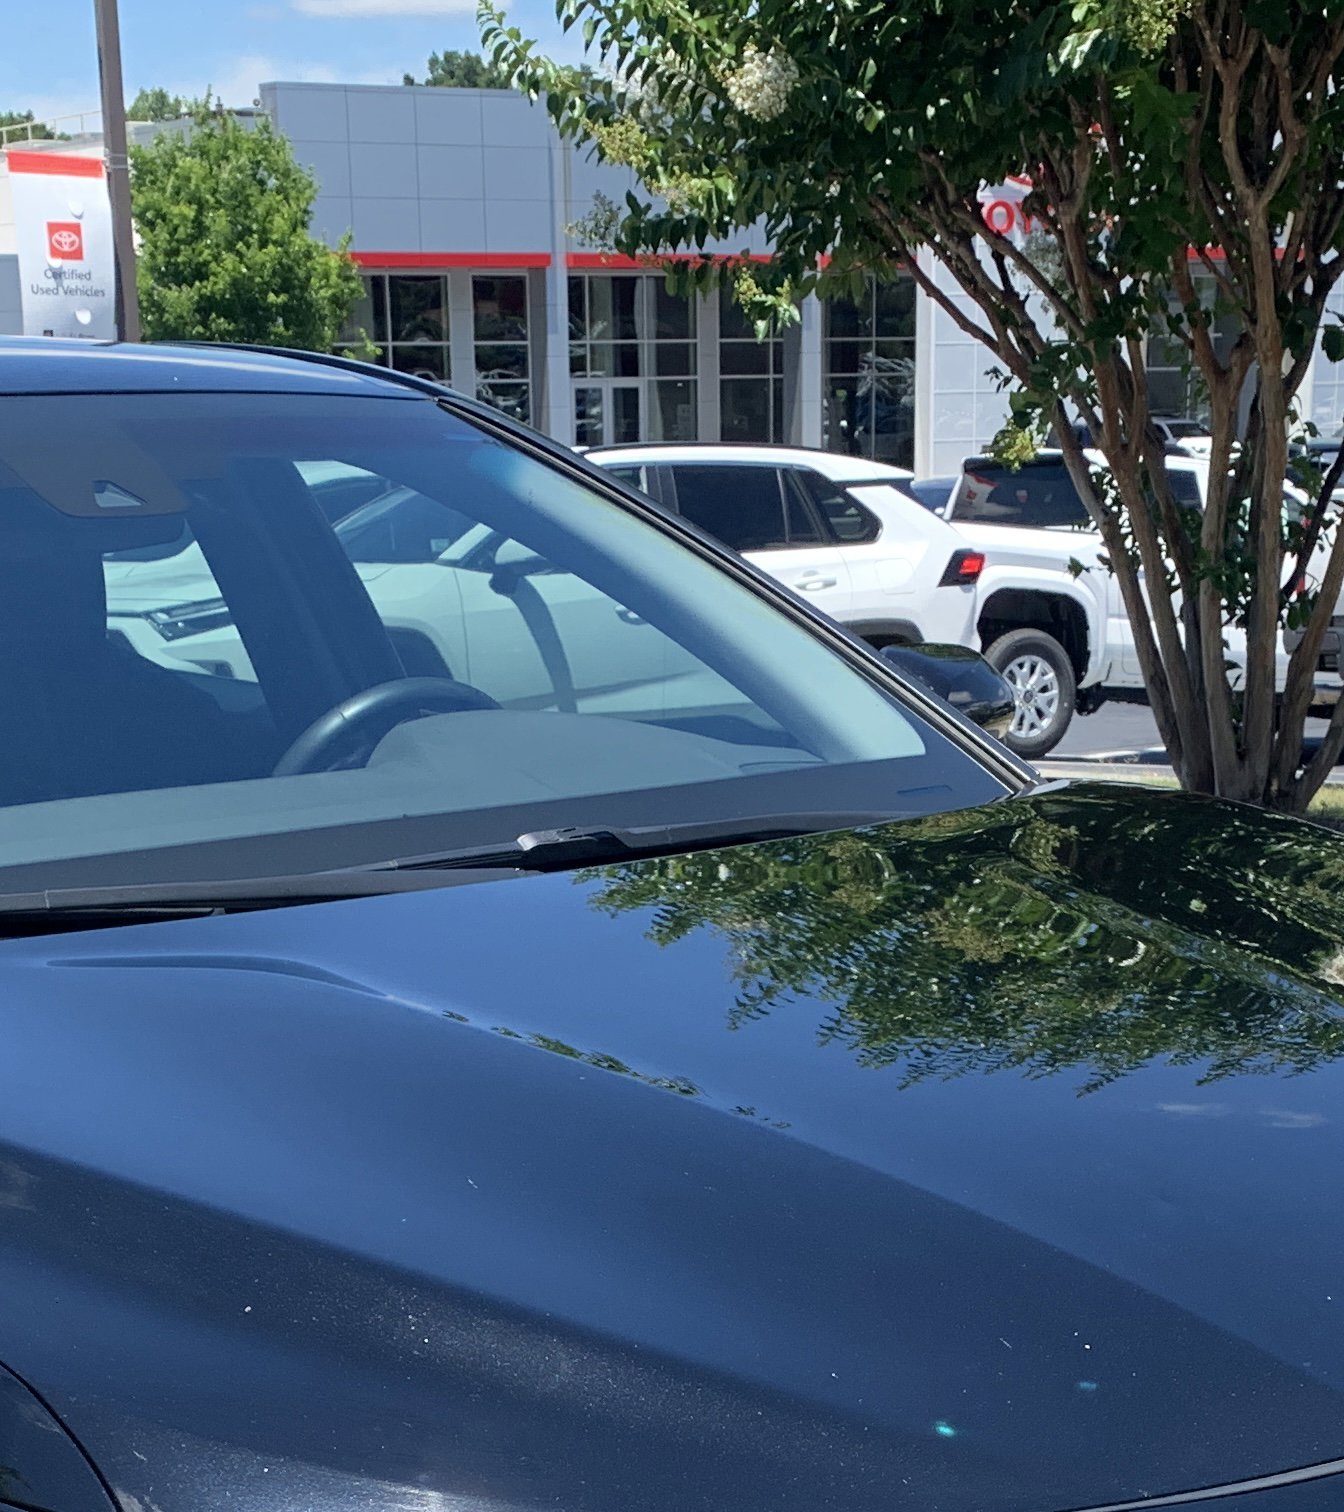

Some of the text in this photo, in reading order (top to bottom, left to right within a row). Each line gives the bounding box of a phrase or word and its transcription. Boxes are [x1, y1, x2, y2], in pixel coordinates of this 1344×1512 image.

[44, 268, 91, 281] Certified
[31, 284, 105, 297] Used Vehicles
